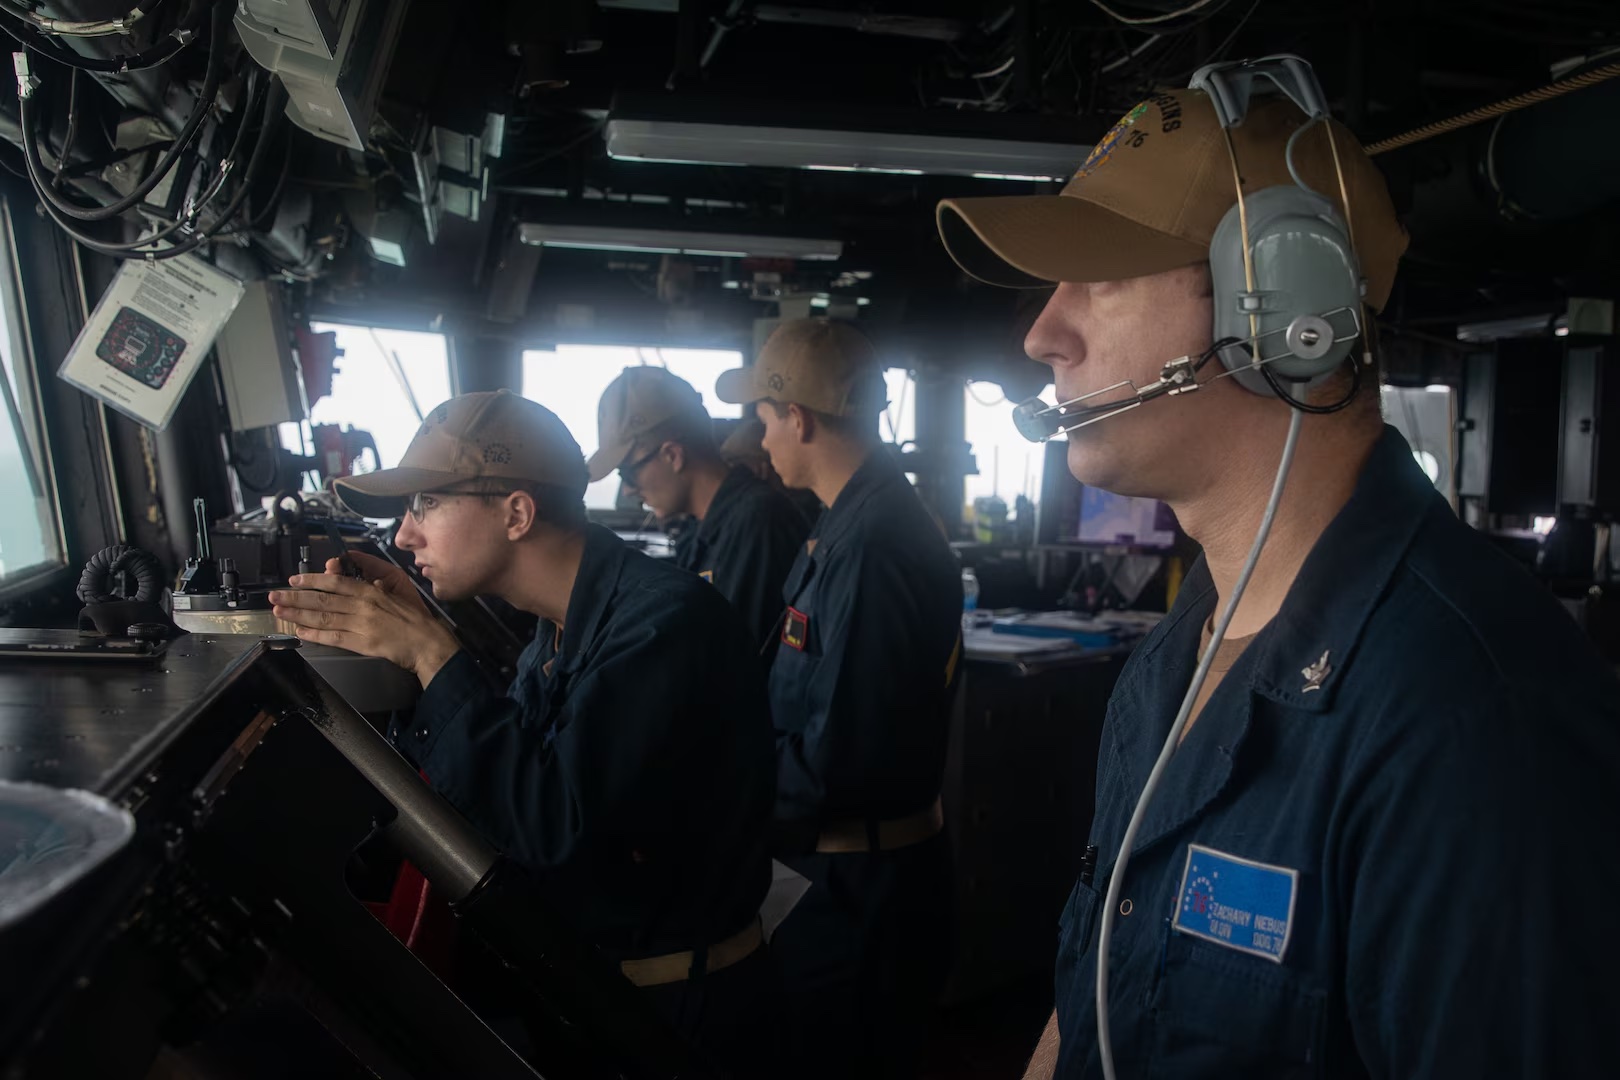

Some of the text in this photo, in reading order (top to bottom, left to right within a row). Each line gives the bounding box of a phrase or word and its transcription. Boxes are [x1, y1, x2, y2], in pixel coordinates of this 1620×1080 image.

[1125, 129, 1149, 148] 76
[1193, 892, 1208, 913] 76
[1213, 902, 1286, 935] ZACHARY NEBUS
